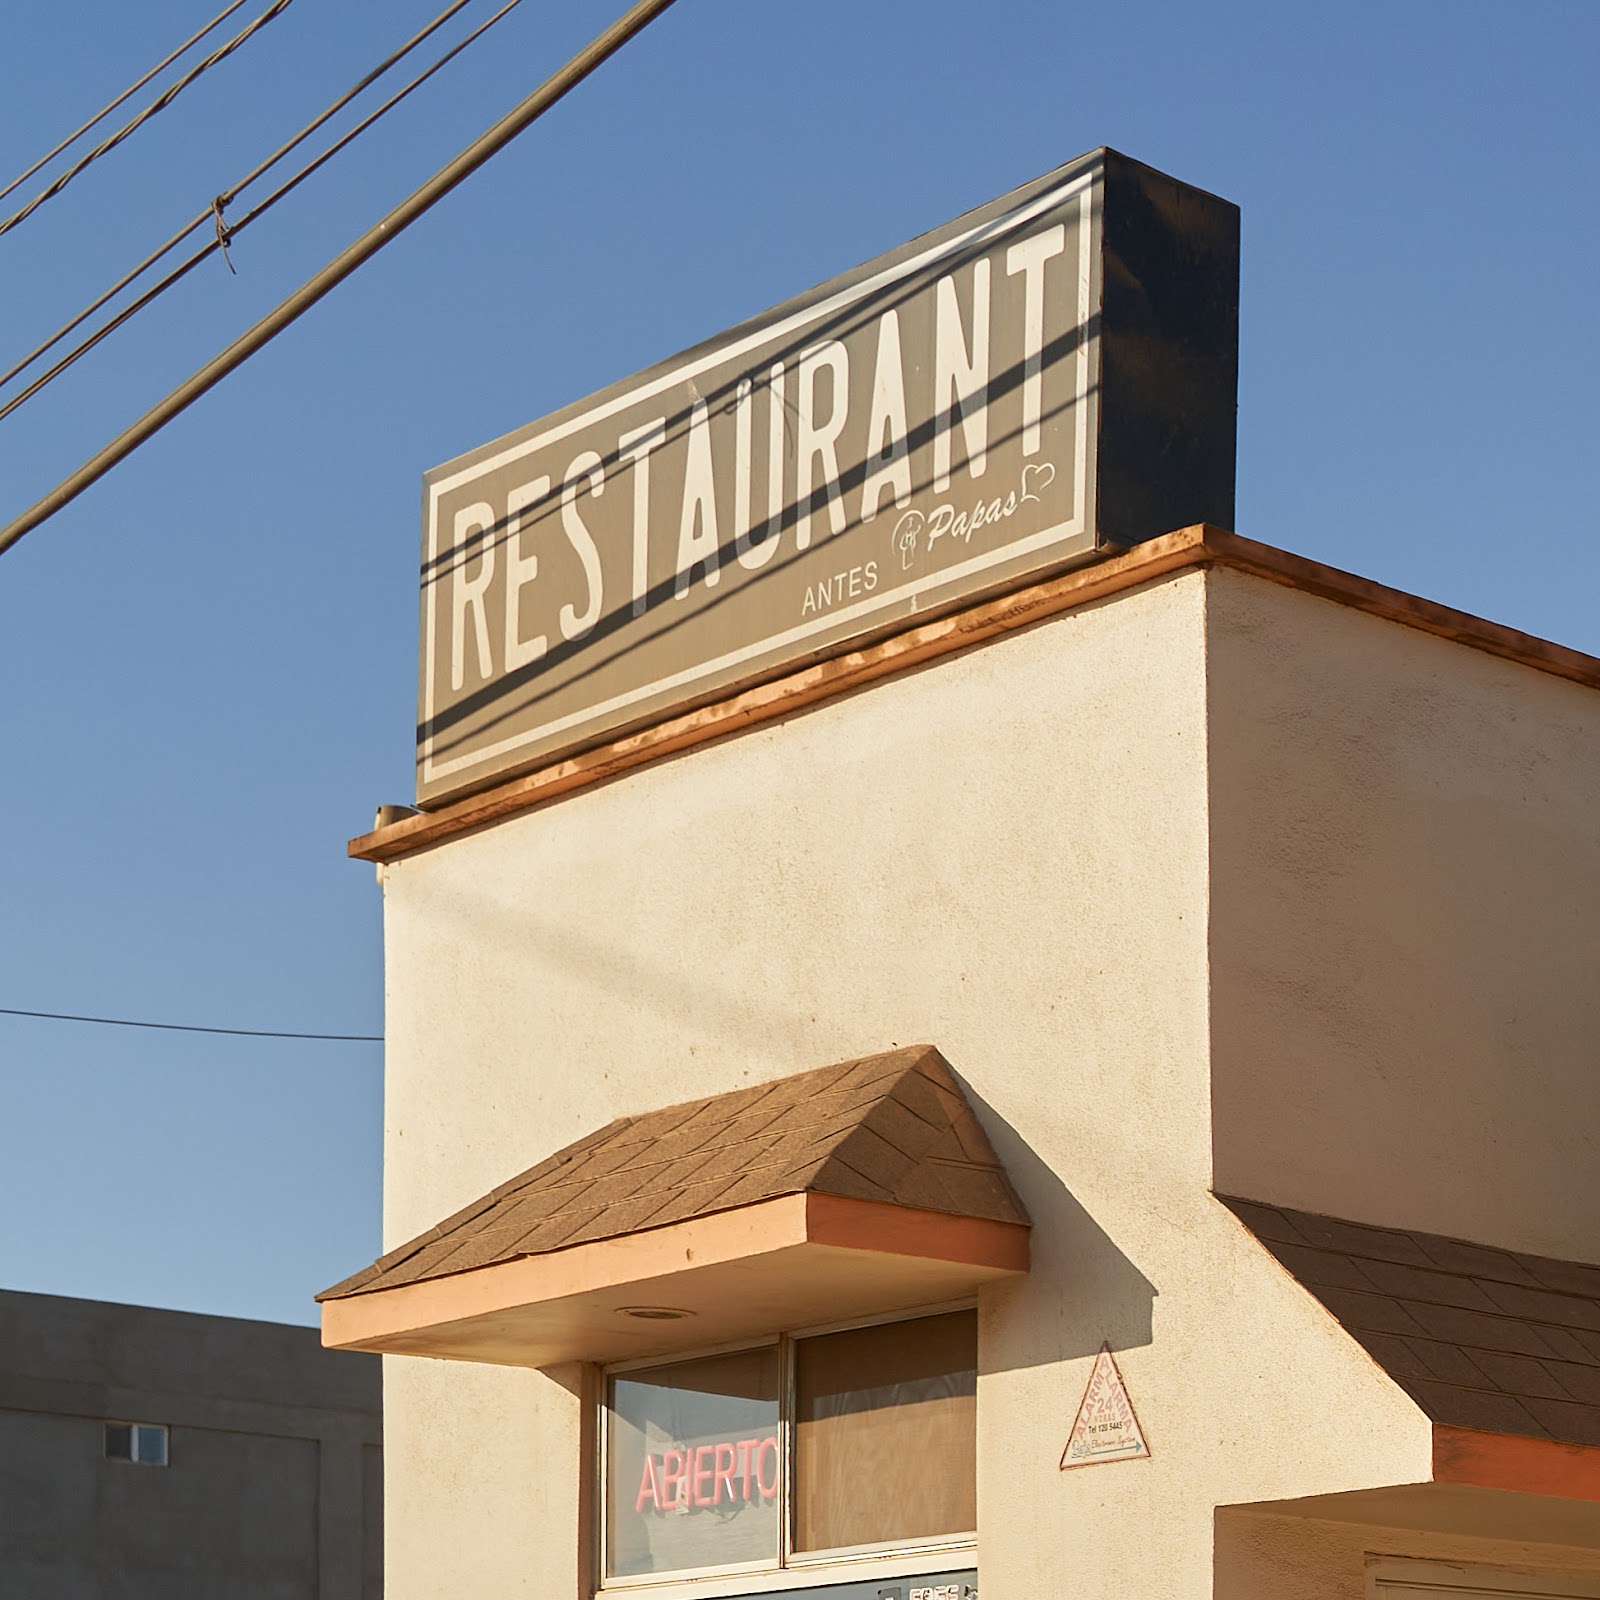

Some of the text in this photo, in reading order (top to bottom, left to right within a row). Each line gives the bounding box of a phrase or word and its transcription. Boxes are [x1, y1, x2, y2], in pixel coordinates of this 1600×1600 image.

[451, 223, 1065, 691] RESTAURANT
[801, 491, 1018, 616] ANTES Papas
[1097, 1396, 1113, 1414] 24
[635, 1436, 779, 1513] ABIERTO
